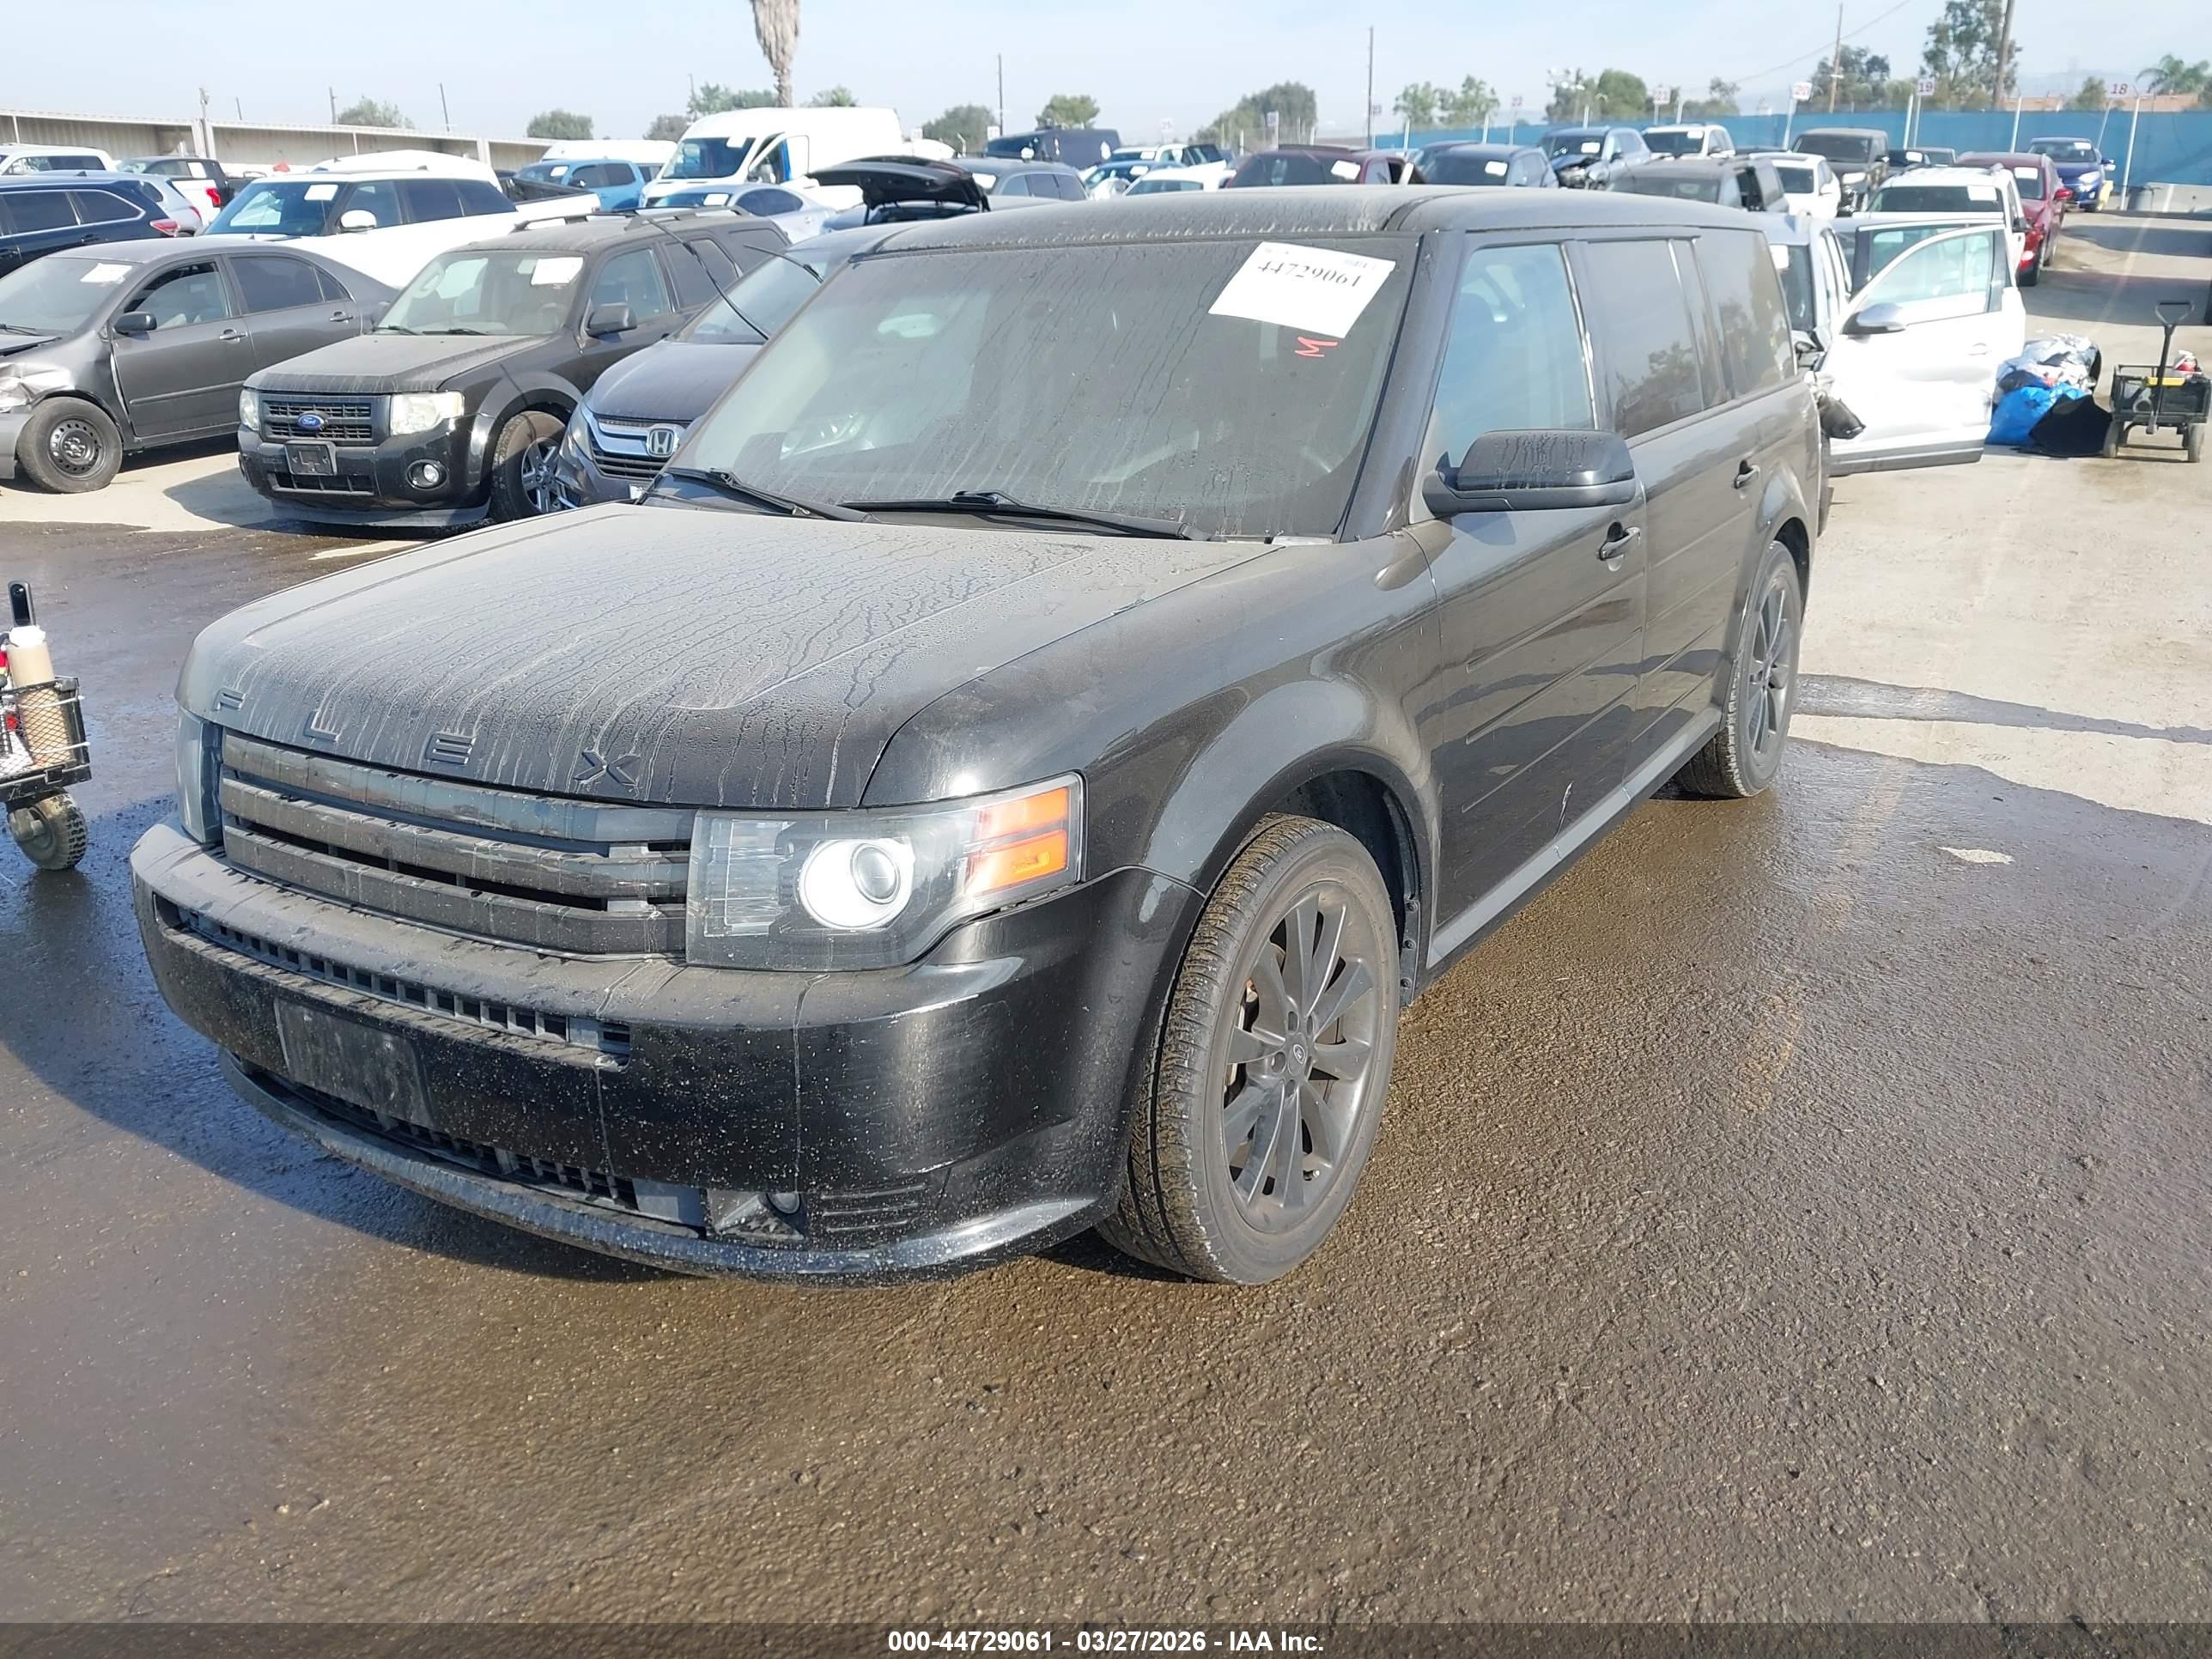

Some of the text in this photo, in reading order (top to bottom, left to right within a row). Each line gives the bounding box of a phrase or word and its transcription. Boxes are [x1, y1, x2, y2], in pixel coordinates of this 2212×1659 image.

[2111, 82, 2128, 94] 18
[1257, 260, 1361, 287] 44729061
[1294, 336, 1338, 357] M
